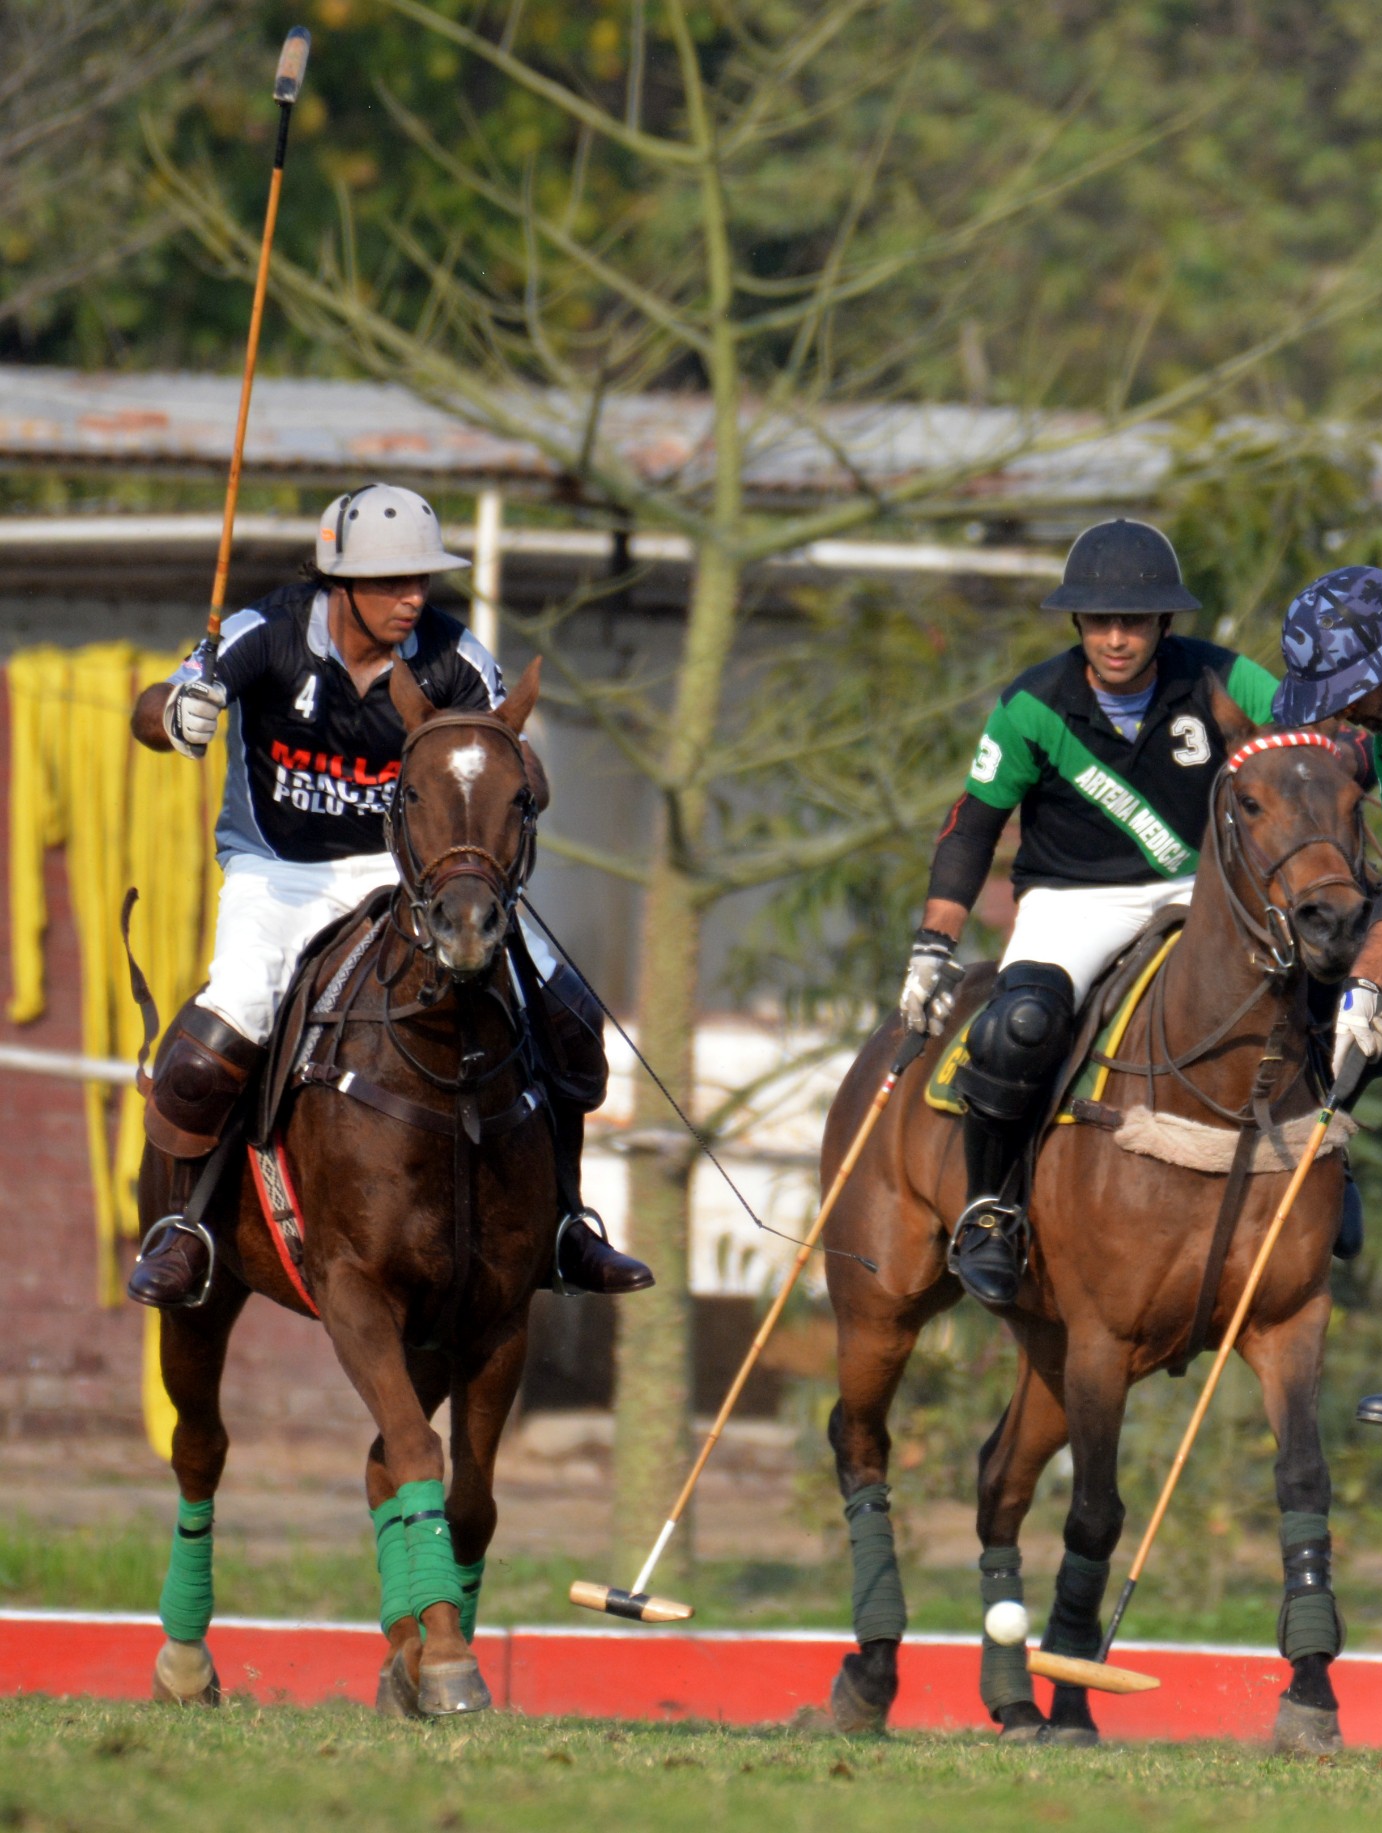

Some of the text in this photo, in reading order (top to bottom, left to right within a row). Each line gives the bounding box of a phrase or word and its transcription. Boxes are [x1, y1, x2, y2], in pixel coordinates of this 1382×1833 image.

[294, 675, 317, 719] 4
[271, 739, 402, 785] MILLA
[971, 733, 1003, 784] 3
[1170, 716, 1212, 767] 3
[1074, 764, 1142, 823] ARTEMA
